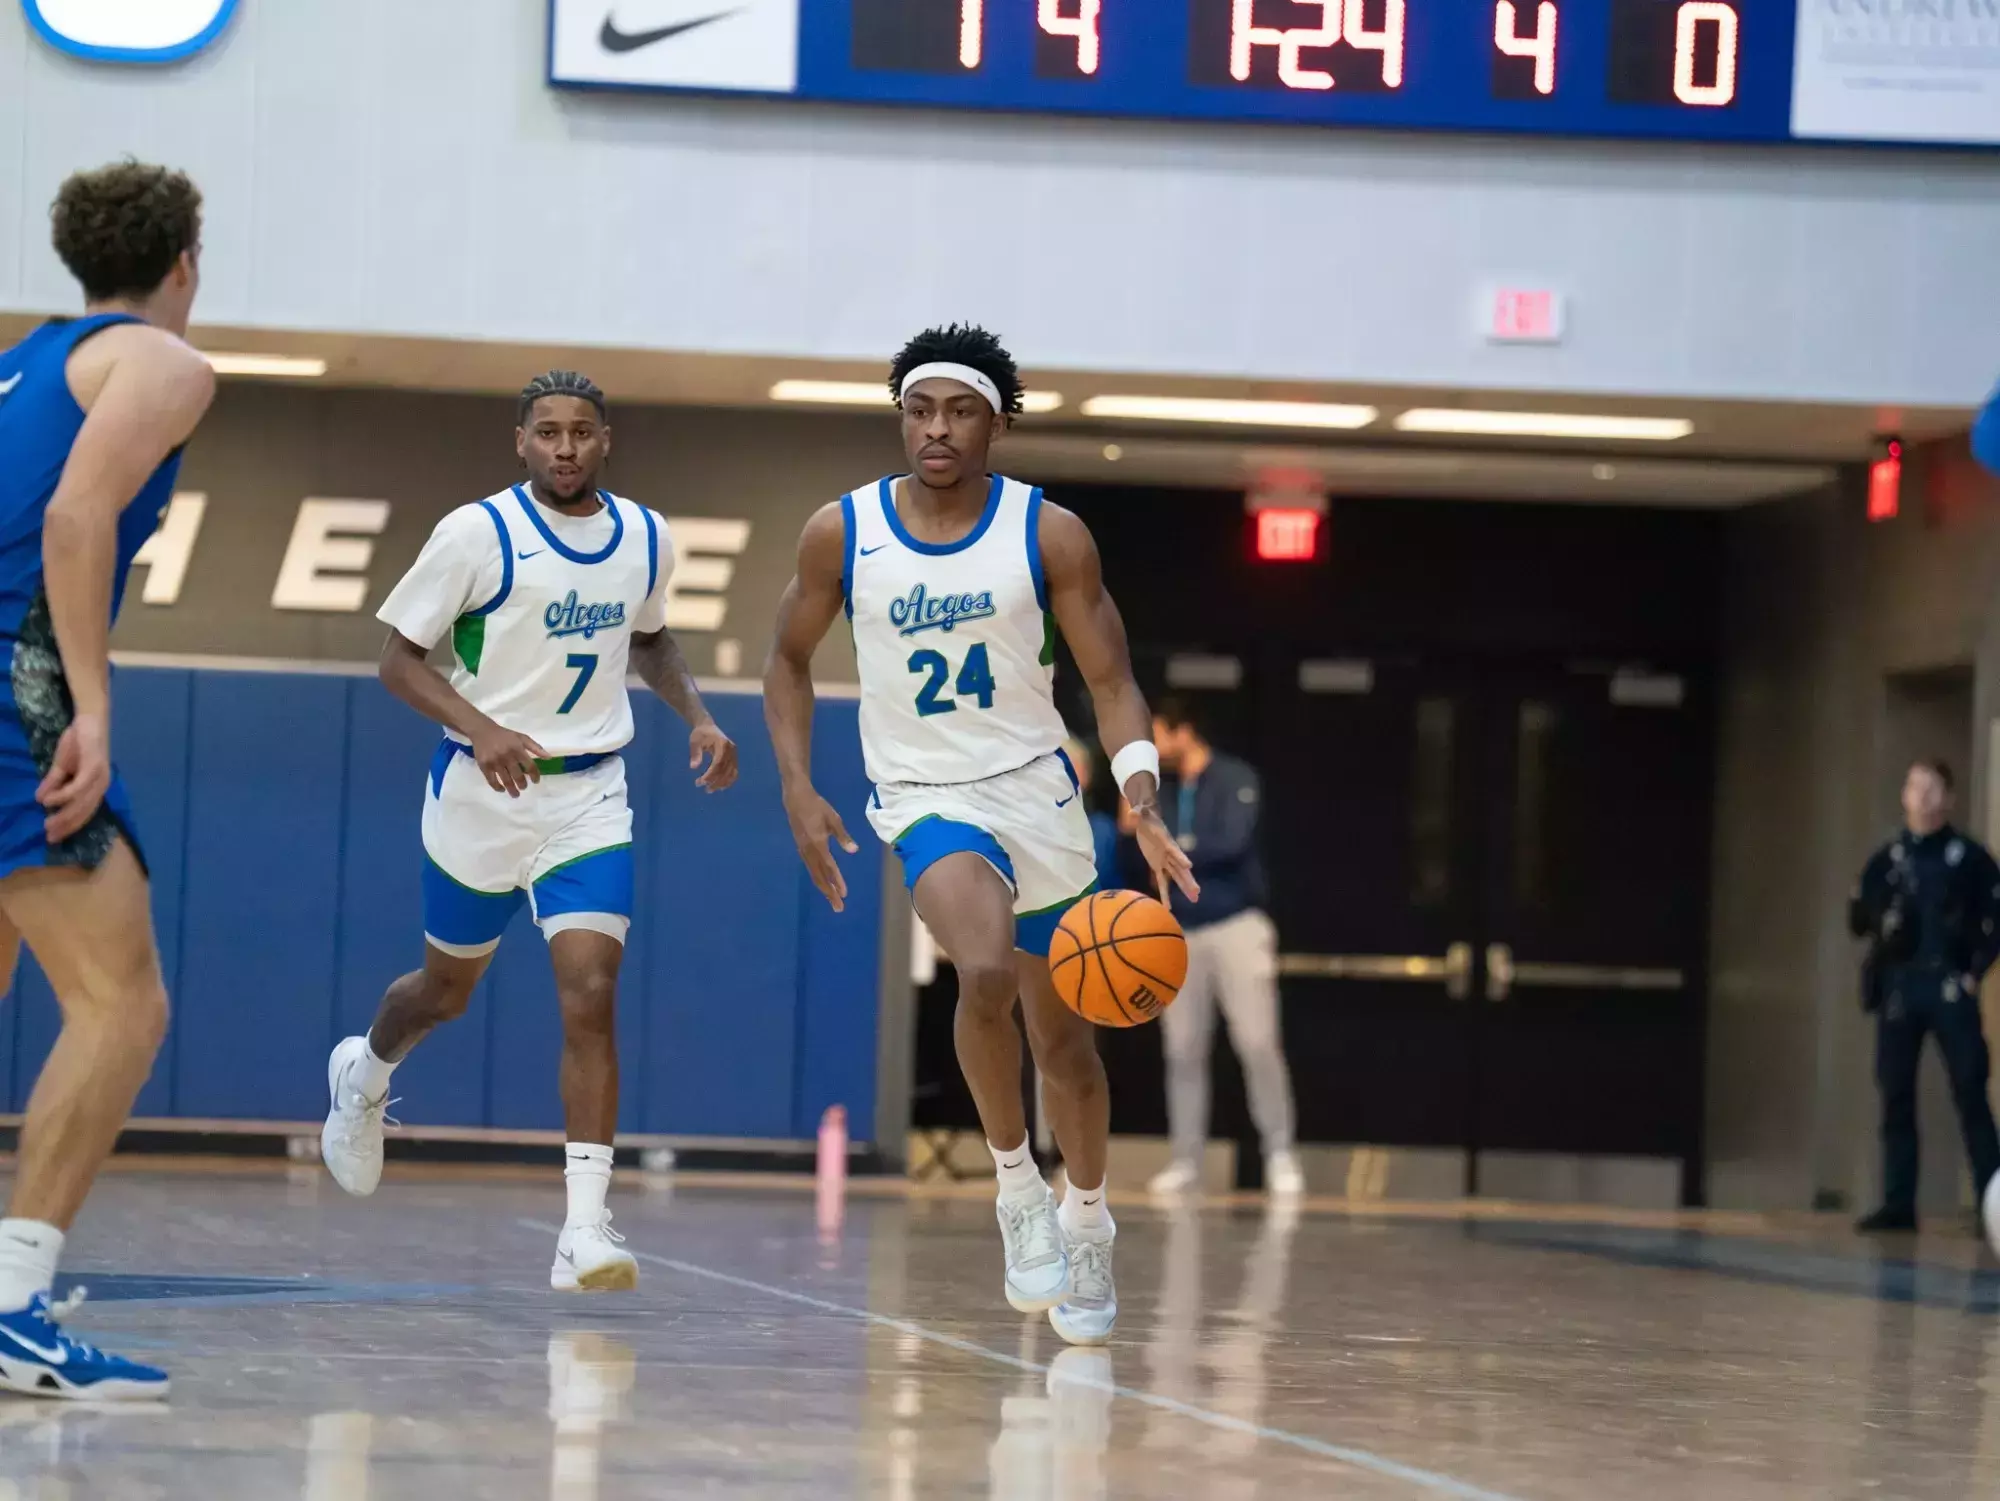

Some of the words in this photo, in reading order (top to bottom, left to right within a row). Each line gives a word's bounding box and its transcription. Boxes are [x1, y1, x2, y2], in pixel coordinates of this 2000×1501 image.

[1037, 0, 1101, 75] 4
[1494, 0, 1557, 94] 4
[1673, 1, 1738, 106] 0
[543, 588, 626, 641] Argos
[889, 581, 997, 637] Argos
[555, 652, 600, 715] 7
[907, 641, 997, 717] 24
